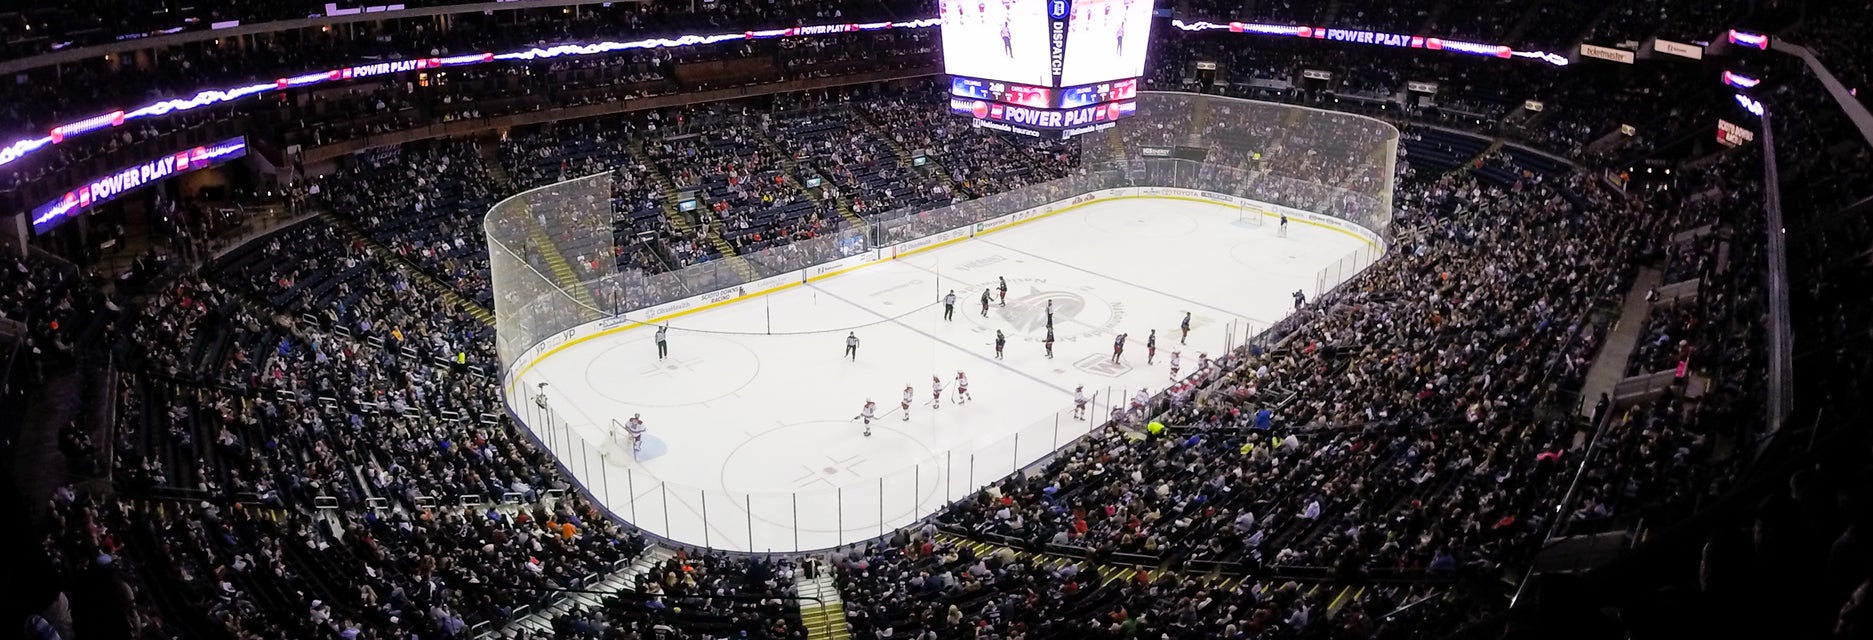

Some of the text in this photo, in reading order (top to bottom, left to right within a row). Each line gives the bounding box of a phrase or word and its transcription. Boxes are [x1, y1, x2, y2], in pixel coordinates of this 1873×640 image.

[801, 23, 845, 35] POWER PLAY
[1327, 28, 1374, 44] POWER
[1374, 32, 1411, 47] PLAY
[1052, 21, 1064, 76] DISPATCH
[353, 62, 390, 77] POWER
[390, 59, 417, 73] PLAY
[1005, 106, 1062, 127] POWER
[1063, 106, 1097, 127] PLAY
[980, 119, 1040, 138] Nationwide Insurance
[91, 170, 141, 201] POWER
[141, 156, 175, 184] PLAY
[1172, 189, 1199, 198] TOYOTA
[701, 286, 739, 301] SCIOTO DOWNS
[711, 294, 731, 304] RACING
